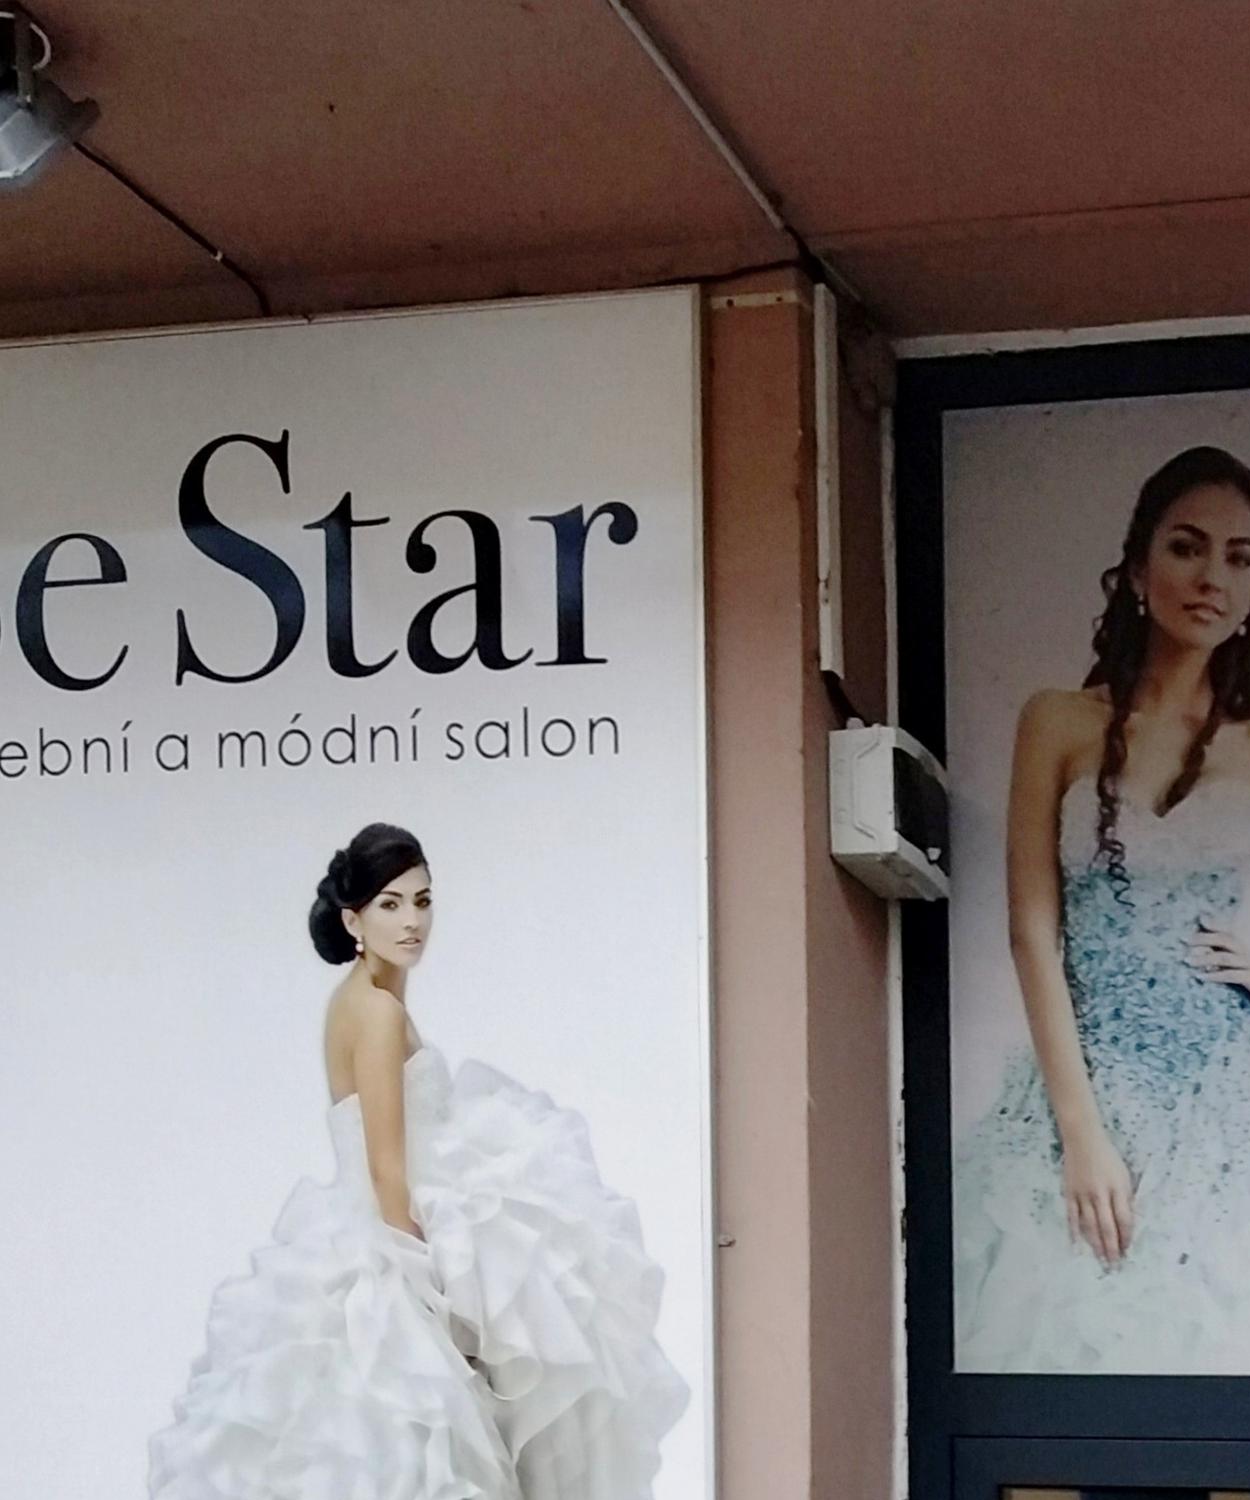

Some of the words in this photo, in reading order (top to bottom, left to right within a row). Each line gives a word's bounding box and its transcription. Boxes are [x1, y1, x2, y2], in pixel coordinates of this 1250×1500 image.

[0, 532, 129, 692] e
[154, 731, 190, 771] a
[217, 709, 419, 769] módní
[444, 707, 621, 761] salon
